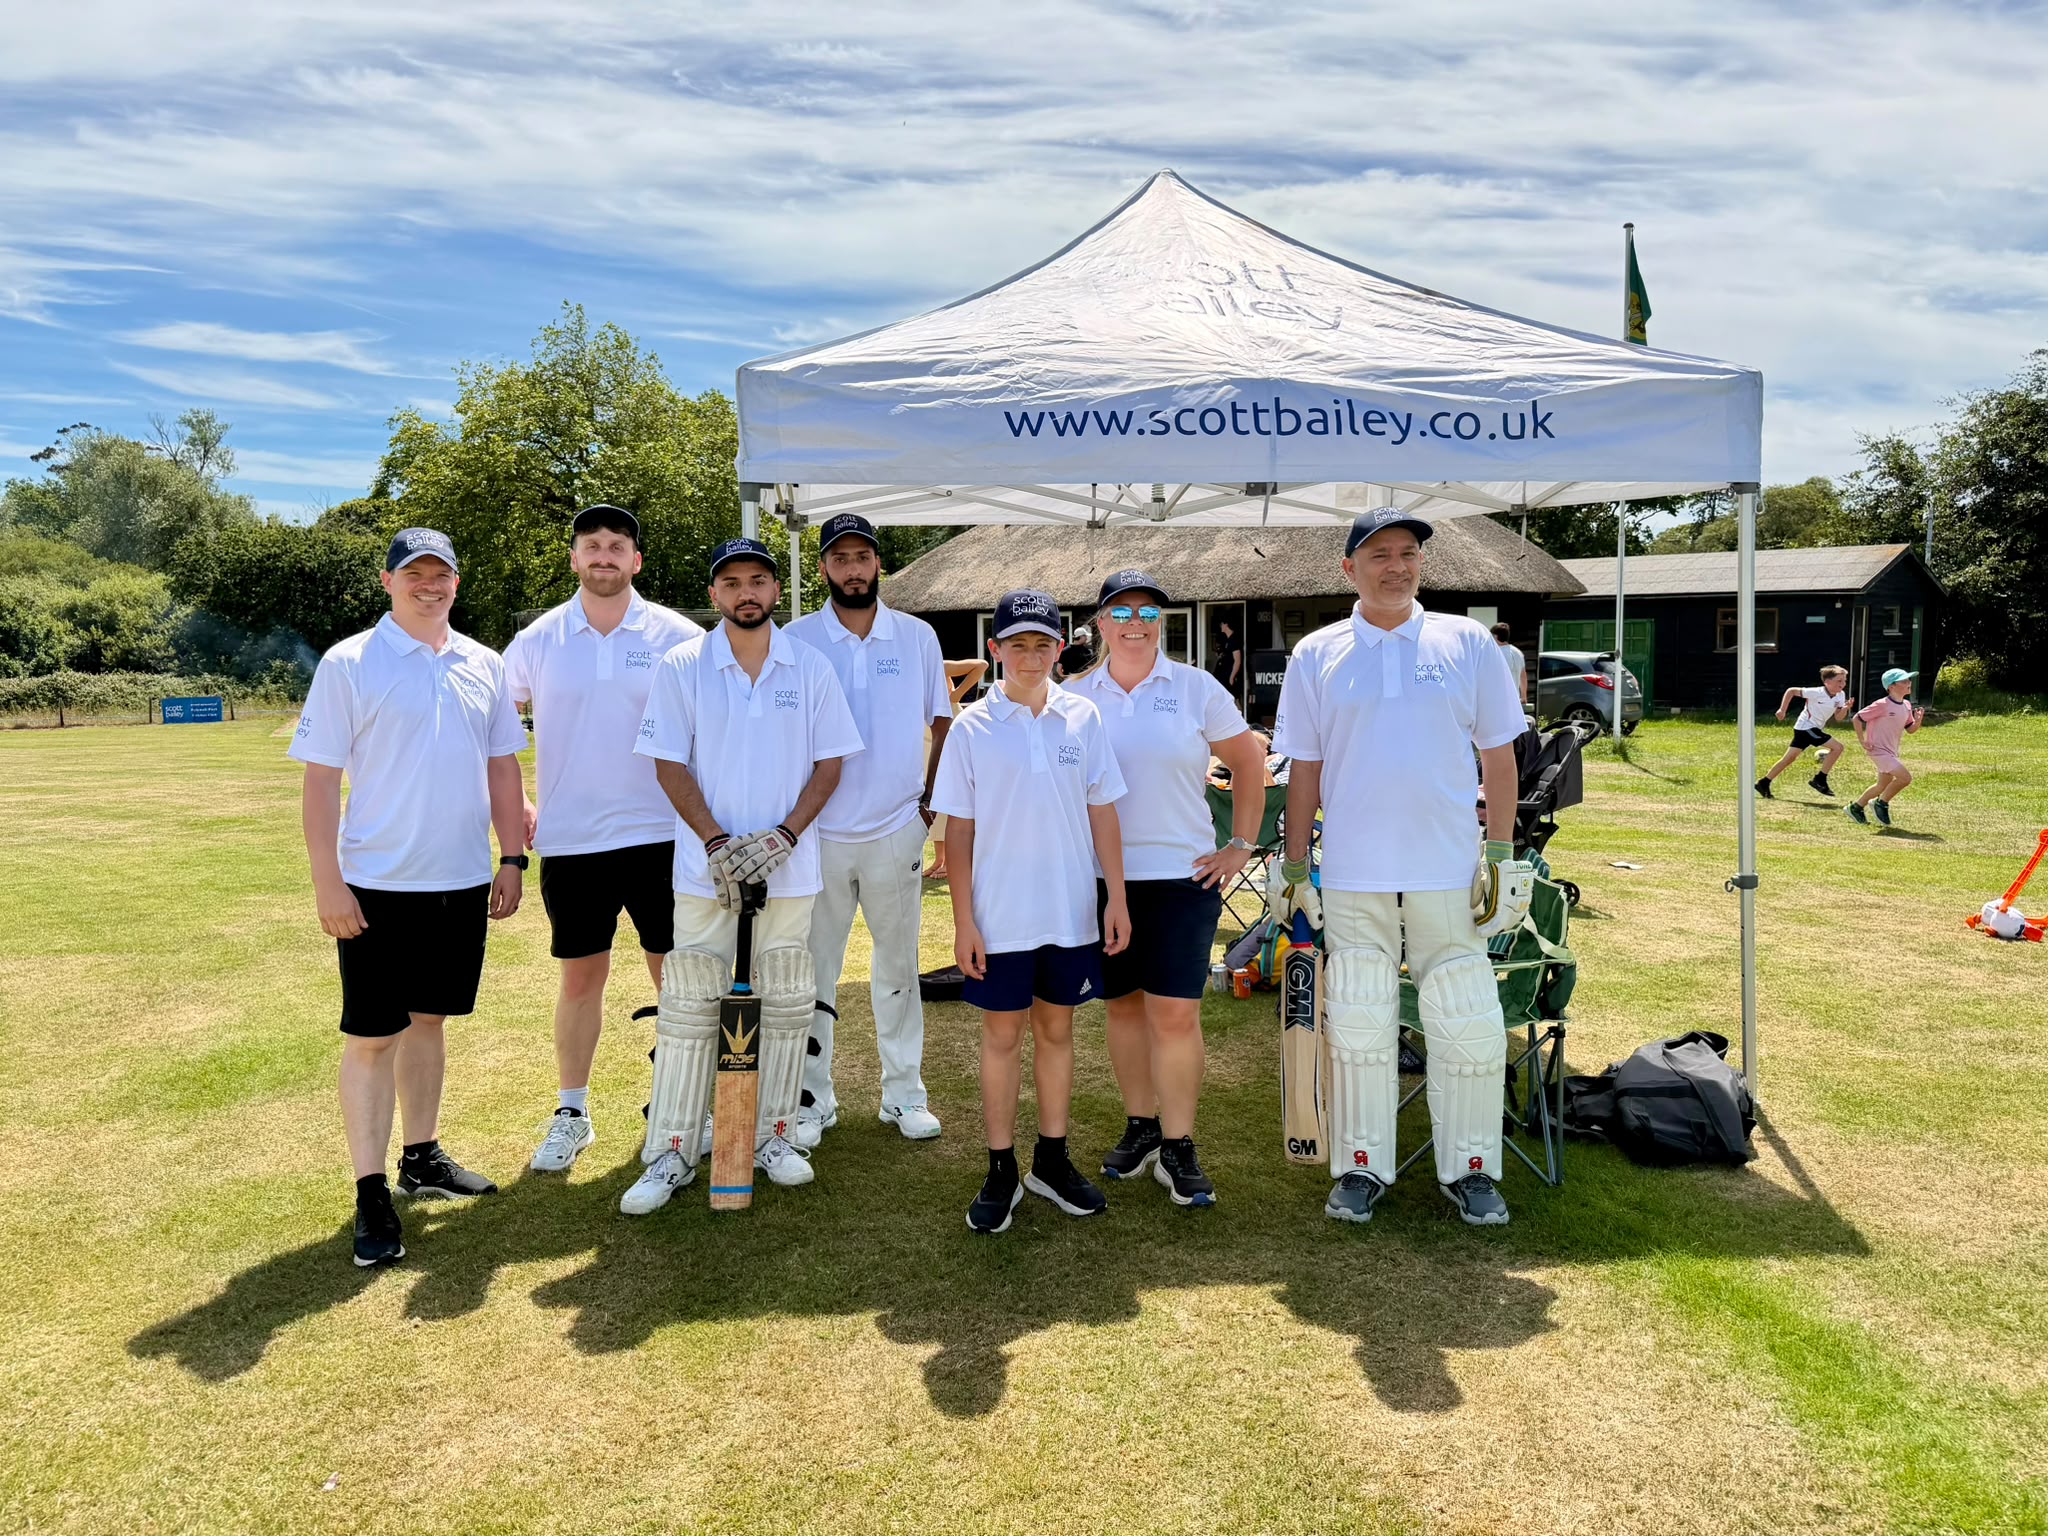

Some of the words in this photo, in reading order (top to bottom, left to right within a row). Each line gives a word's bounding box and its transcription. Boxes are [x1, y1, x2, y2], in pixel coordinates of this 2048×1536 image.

[1004, 396, 1556, 445] www.scottbailey.co.uk
[1013, 595, 1049, 607] scott
[1012, 602, 1050, 616] bailey
[627, 650, 652, 660] scott
[626, 658, 652, 670] bailey
[877, 658, 900, 667] scott
[1415, 663, 1445, 673] scott
[876, 666, 900, 676] bailey
[1255, 672, 1285, 685] WICKE
[1414, 671, 1444, 684] bailey
[775, 690, 799, 700] scott
[1154, 696, 1178, 706] scott
[775, 697, 800, 710] bailey
[1153, 703, 1178, 715] bailey
[1058, 745, 1081, 757] scott
[1058, 753, 1080, 767] bailey
[1287, 1137, 1318, 1156] GM
